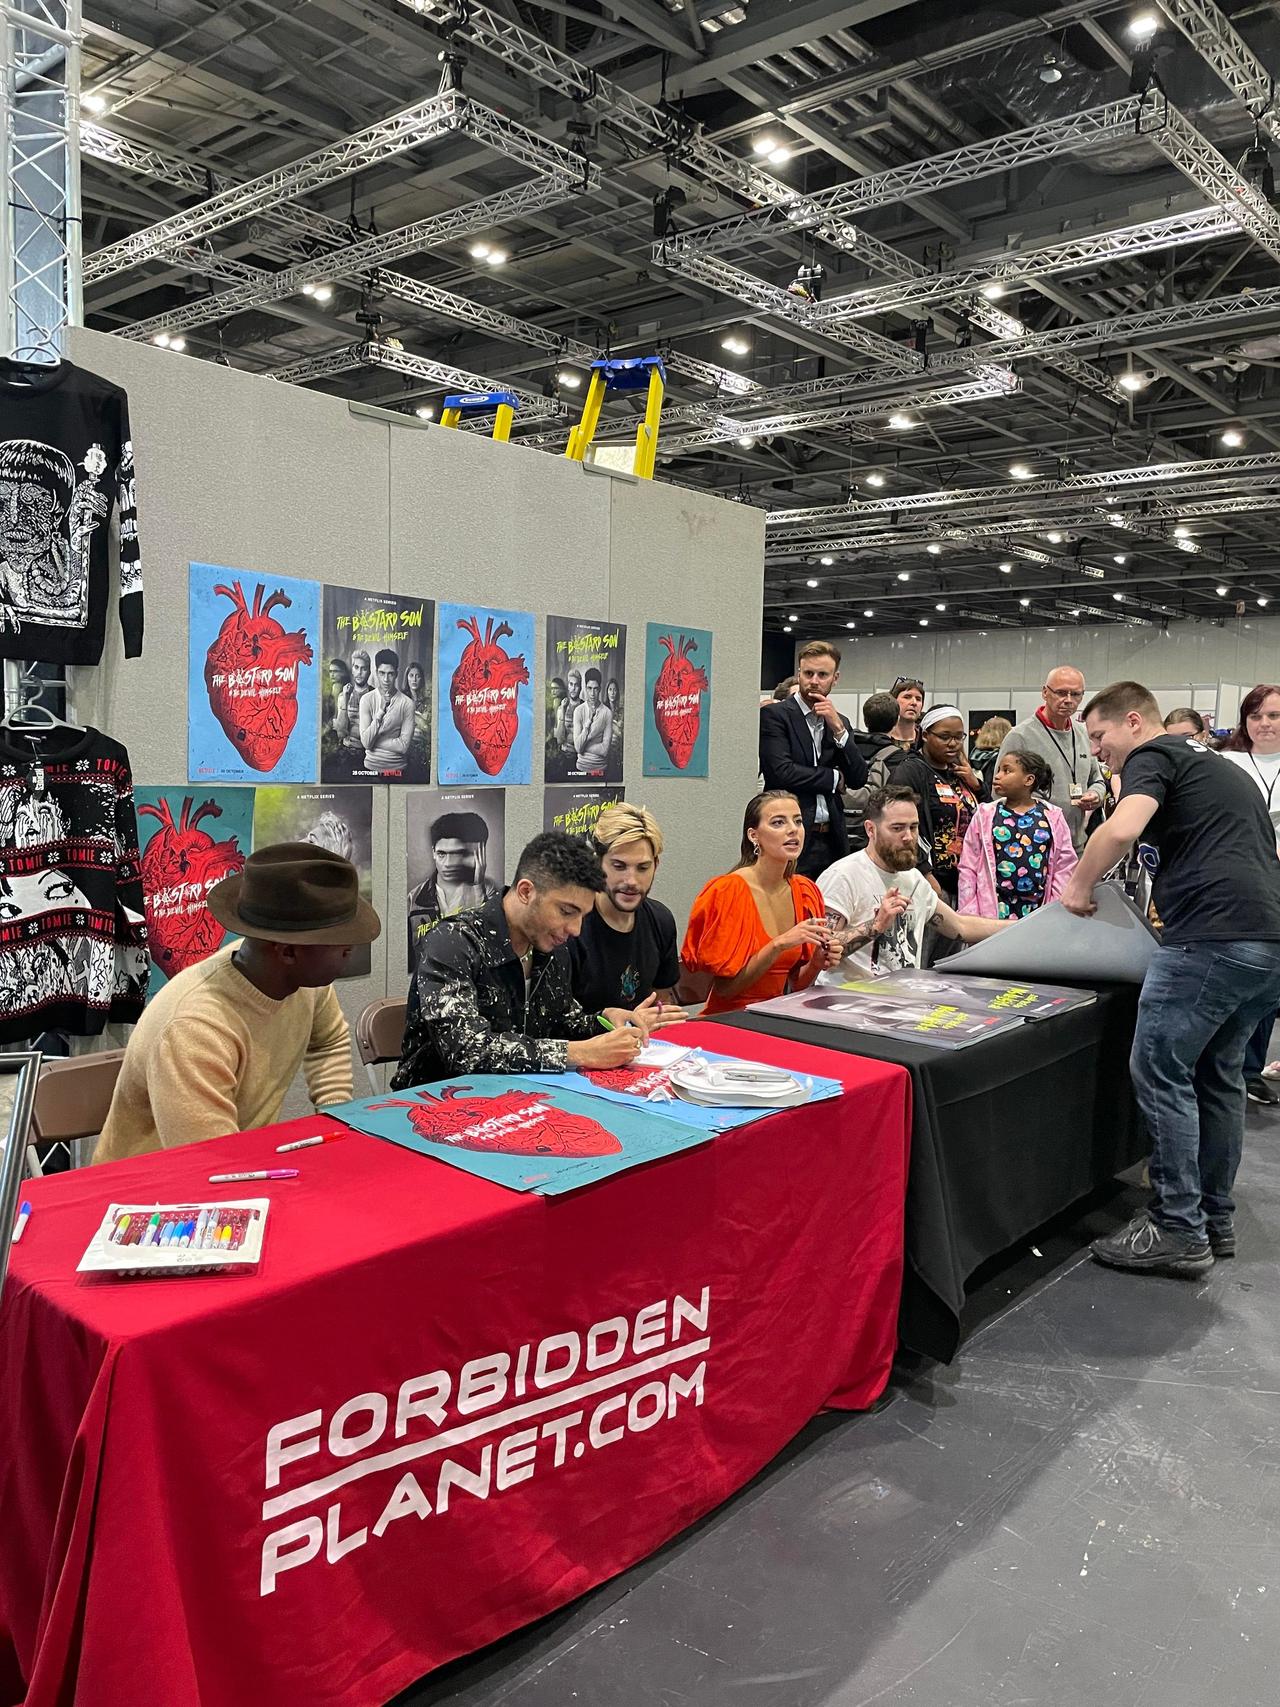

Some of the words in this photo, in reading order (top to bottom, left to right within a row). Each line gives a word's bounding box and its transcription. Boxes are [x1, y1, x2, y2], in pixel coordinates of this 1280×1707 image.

[336, 615, 351, 631] THE
[352, 608, 399, 632] BASTARD
[400, 603, 424, 628] SON
[603, 628, 620, 649] SON
[212, 674, 226, 688] THE
[275, 661, 297, 682] SON
[501, 681, 517, 700] SON
[9, 854, 44, 873] TOMIE
[66, 848, 96, 863] TOMIE
[41, 913, 73, 931] TOMIE
[265, 1286, 711, 1490] FORBIDDEN
[260, 1360, 707, 1597] PLANET.COM
